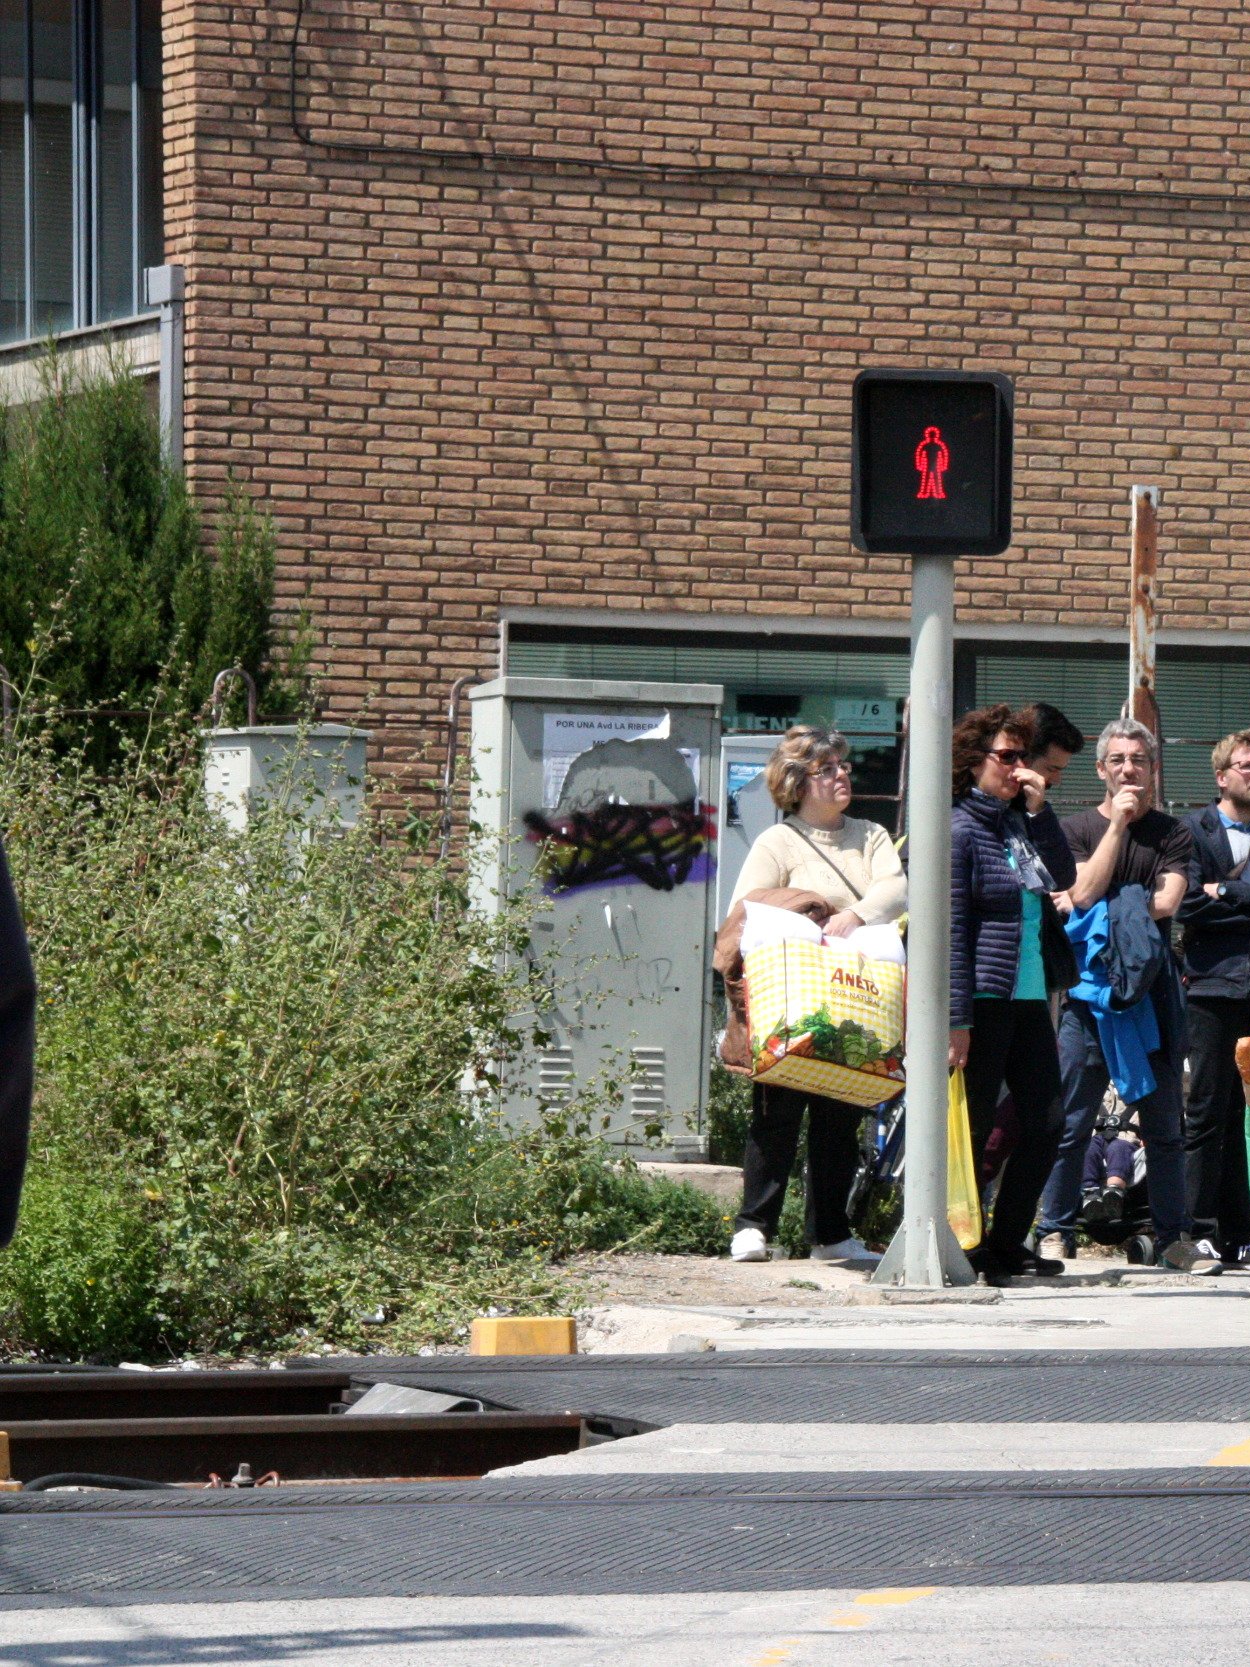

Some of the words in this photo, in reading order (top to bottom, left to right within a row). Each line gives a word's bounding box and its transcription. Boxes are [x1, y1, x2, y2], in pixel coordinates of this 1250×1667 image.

[556, 720, 575, 728] POR
[577, 721, 595, 729] UNA
[614, 722, 626, 730] LA
[628, 722, 660, 731] RIBERA
[831, 967, 880, 996] ANETO
[849, 991, 881, 1008] NATURA
